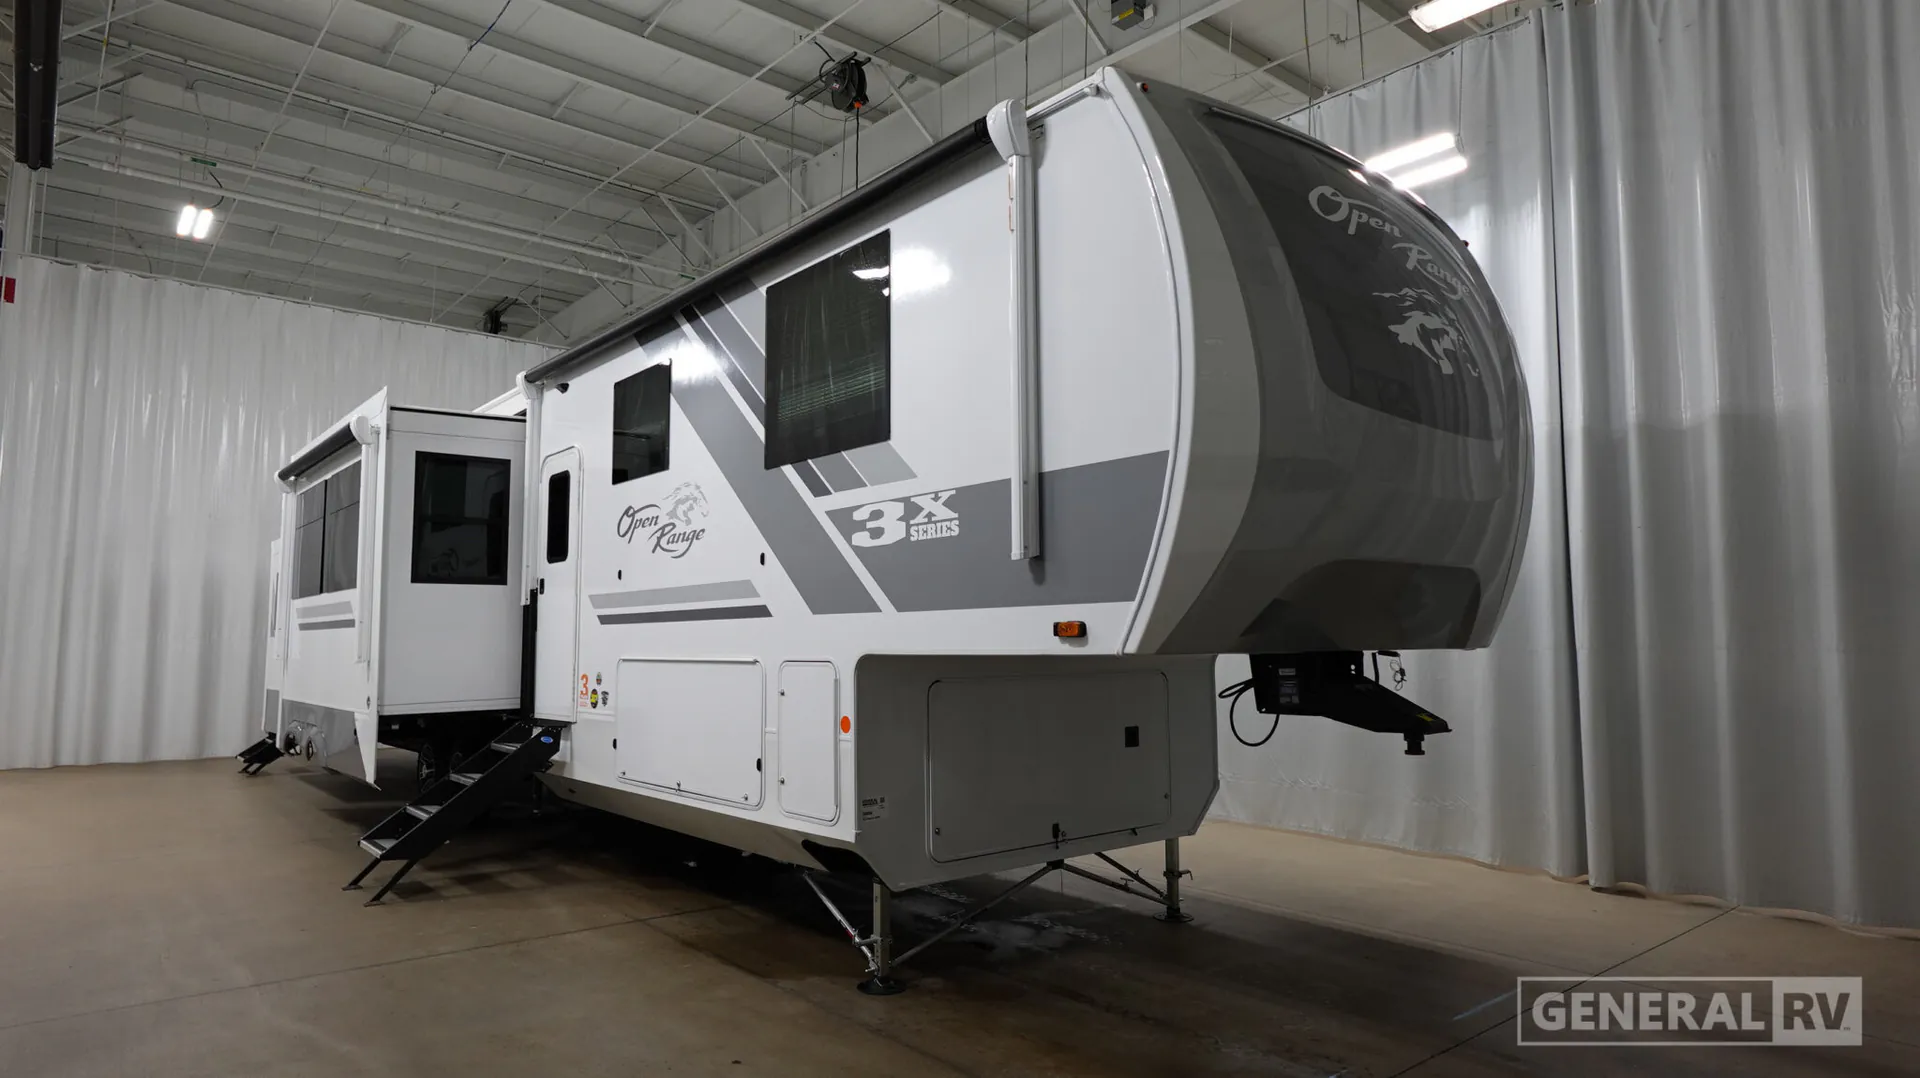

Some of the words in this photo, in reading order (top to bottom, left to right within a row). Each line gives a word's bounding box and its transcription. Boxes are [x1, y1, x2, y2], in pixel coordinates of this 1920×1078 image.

[1308, 185, 1403, 237] Open
[1391, 242, 1470, 300] Range
[617, 503, 661, 544] Open
[646, 522, 706, 559] Range
[910, 520, 960, 541] SERIES
